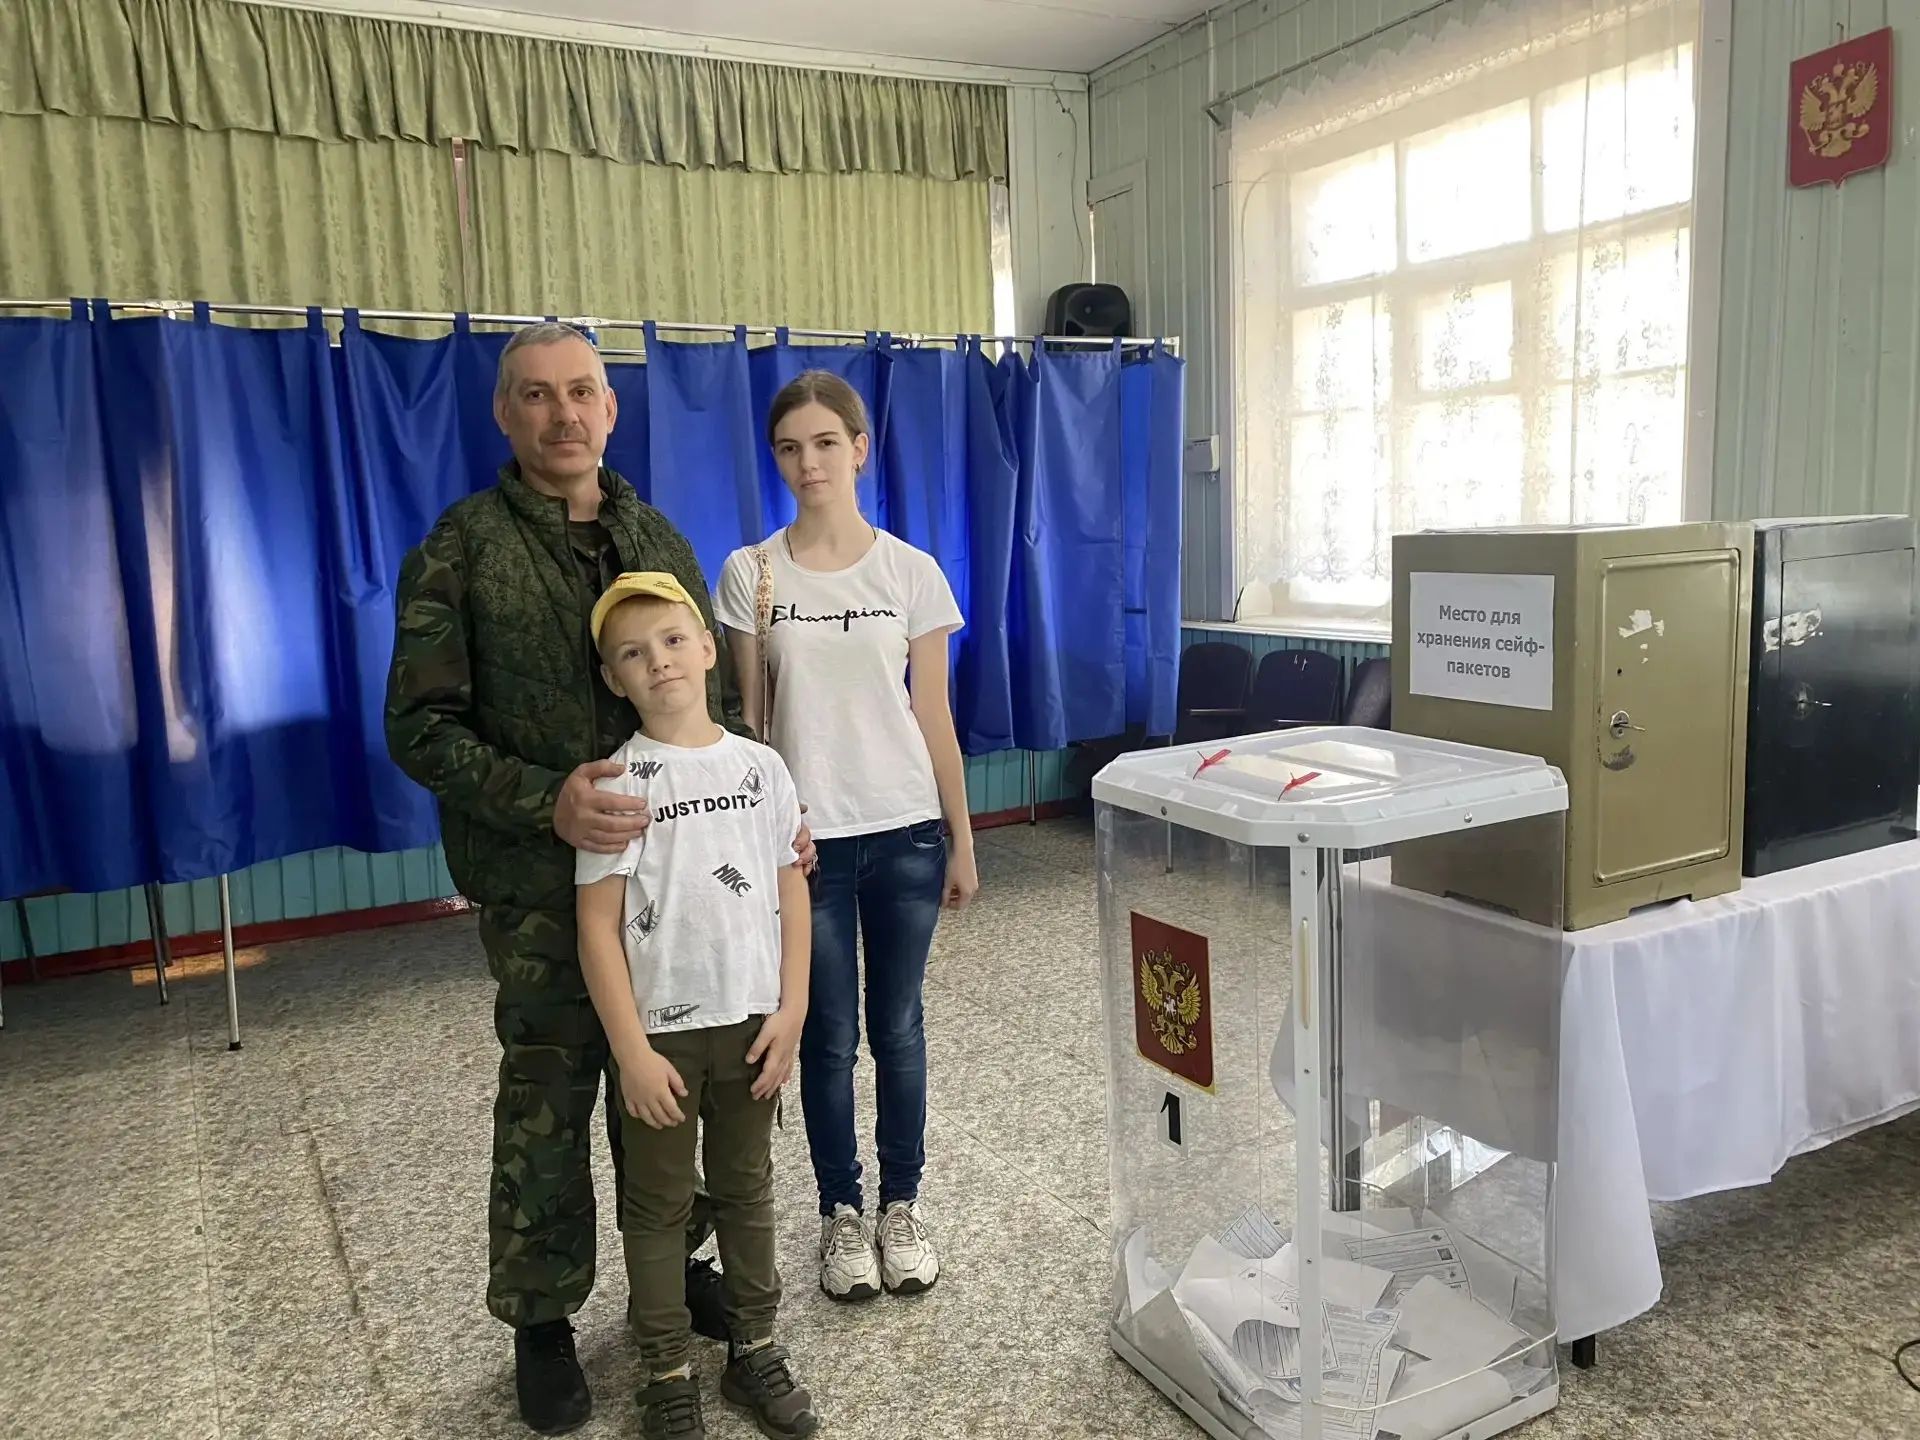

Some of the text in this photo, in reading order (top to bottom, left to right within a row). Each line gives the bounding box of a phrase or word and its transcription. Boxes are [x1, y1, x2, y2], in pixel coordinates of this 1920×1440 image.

[770, 603, 897, 632] Champion
[1439, 605, 1521, 626] Место для
[1416, 632, 1545, 657] хранения сейф-
[1447, 660, 1511, 679] пакетов
[655, 799, 701, 823] JUST
[711, 863, 752, 898] NIKE
[1160, 1091, 1181, 1145] 1
